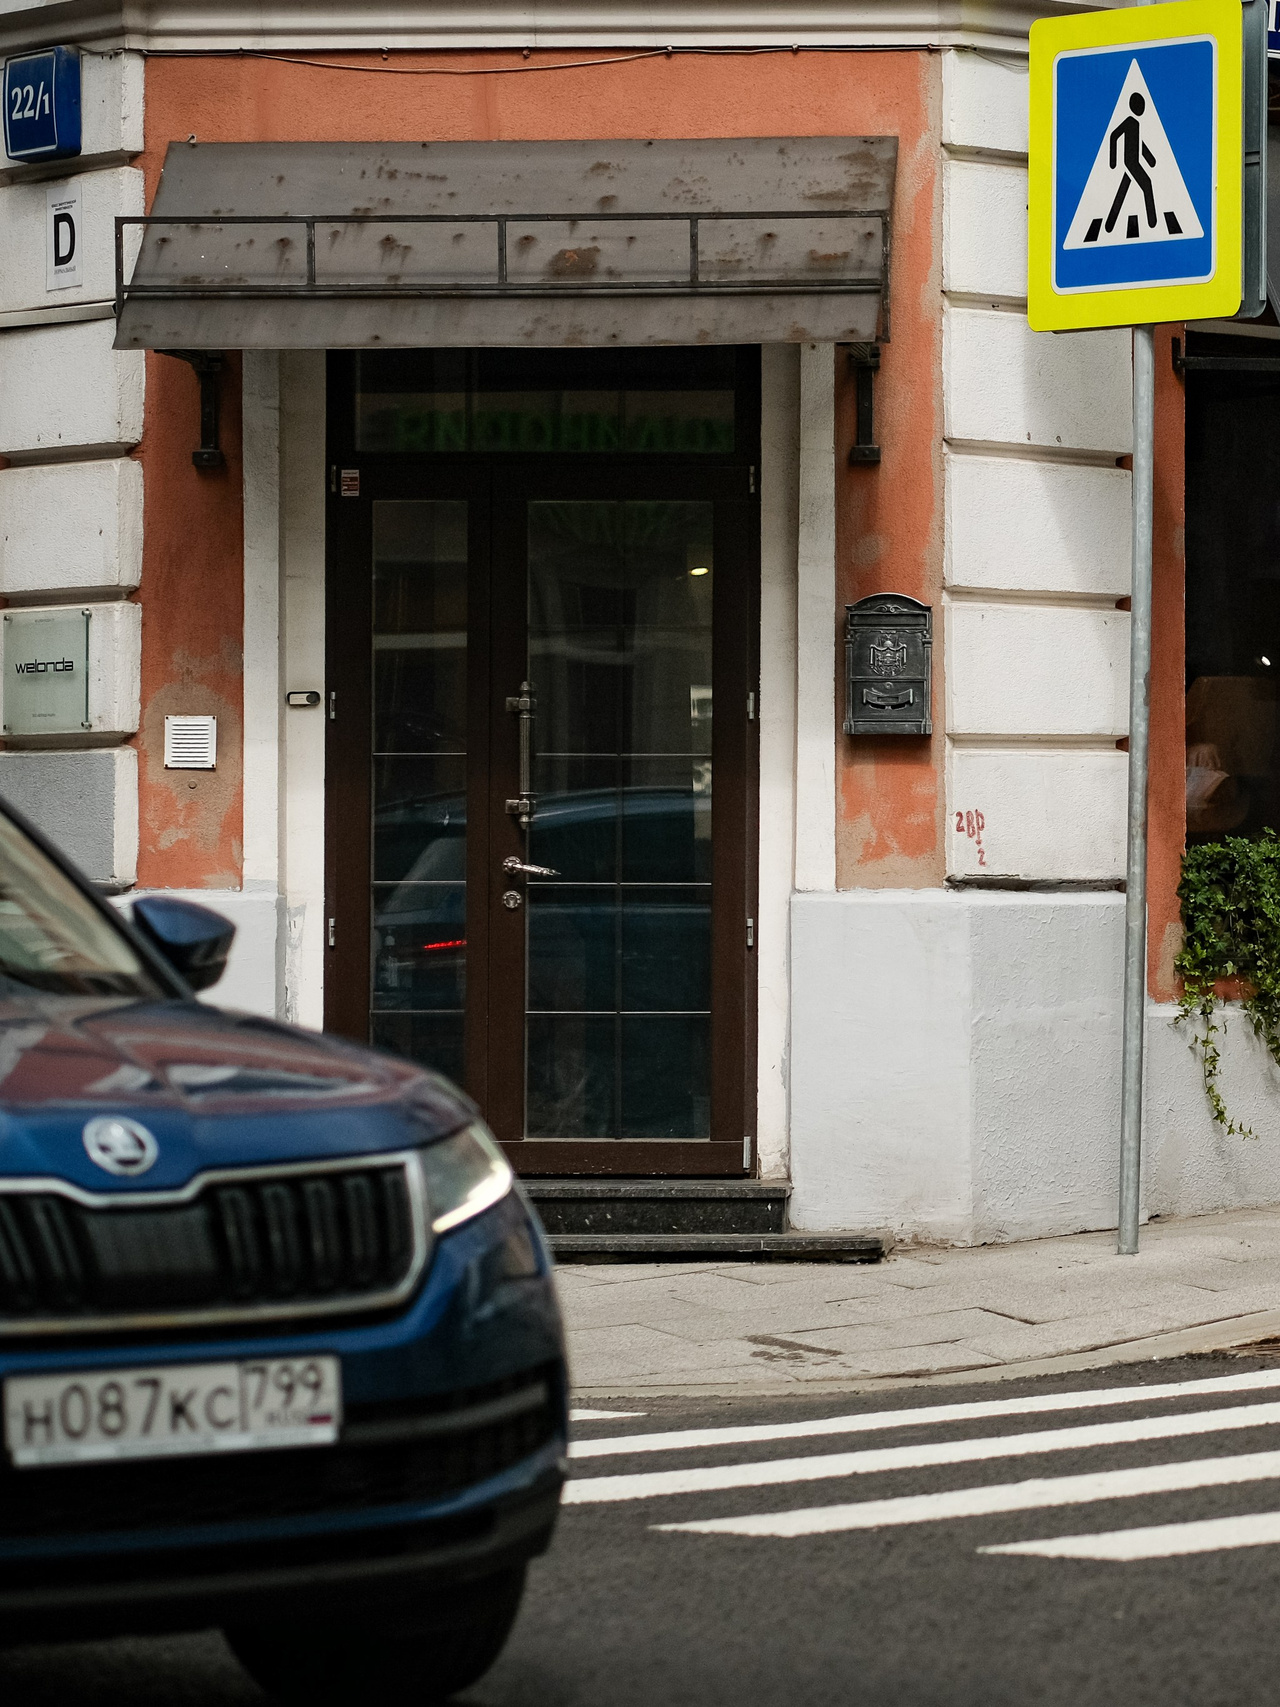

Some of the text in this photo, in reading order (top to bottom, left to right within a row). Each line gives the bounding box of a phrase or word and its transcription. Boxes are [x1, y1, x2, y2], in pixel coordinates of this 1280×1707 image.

[11, 81, 50, 121] 22/1
[54, 213, 76, 267] D
[15, 657, 74, 674] welonda
